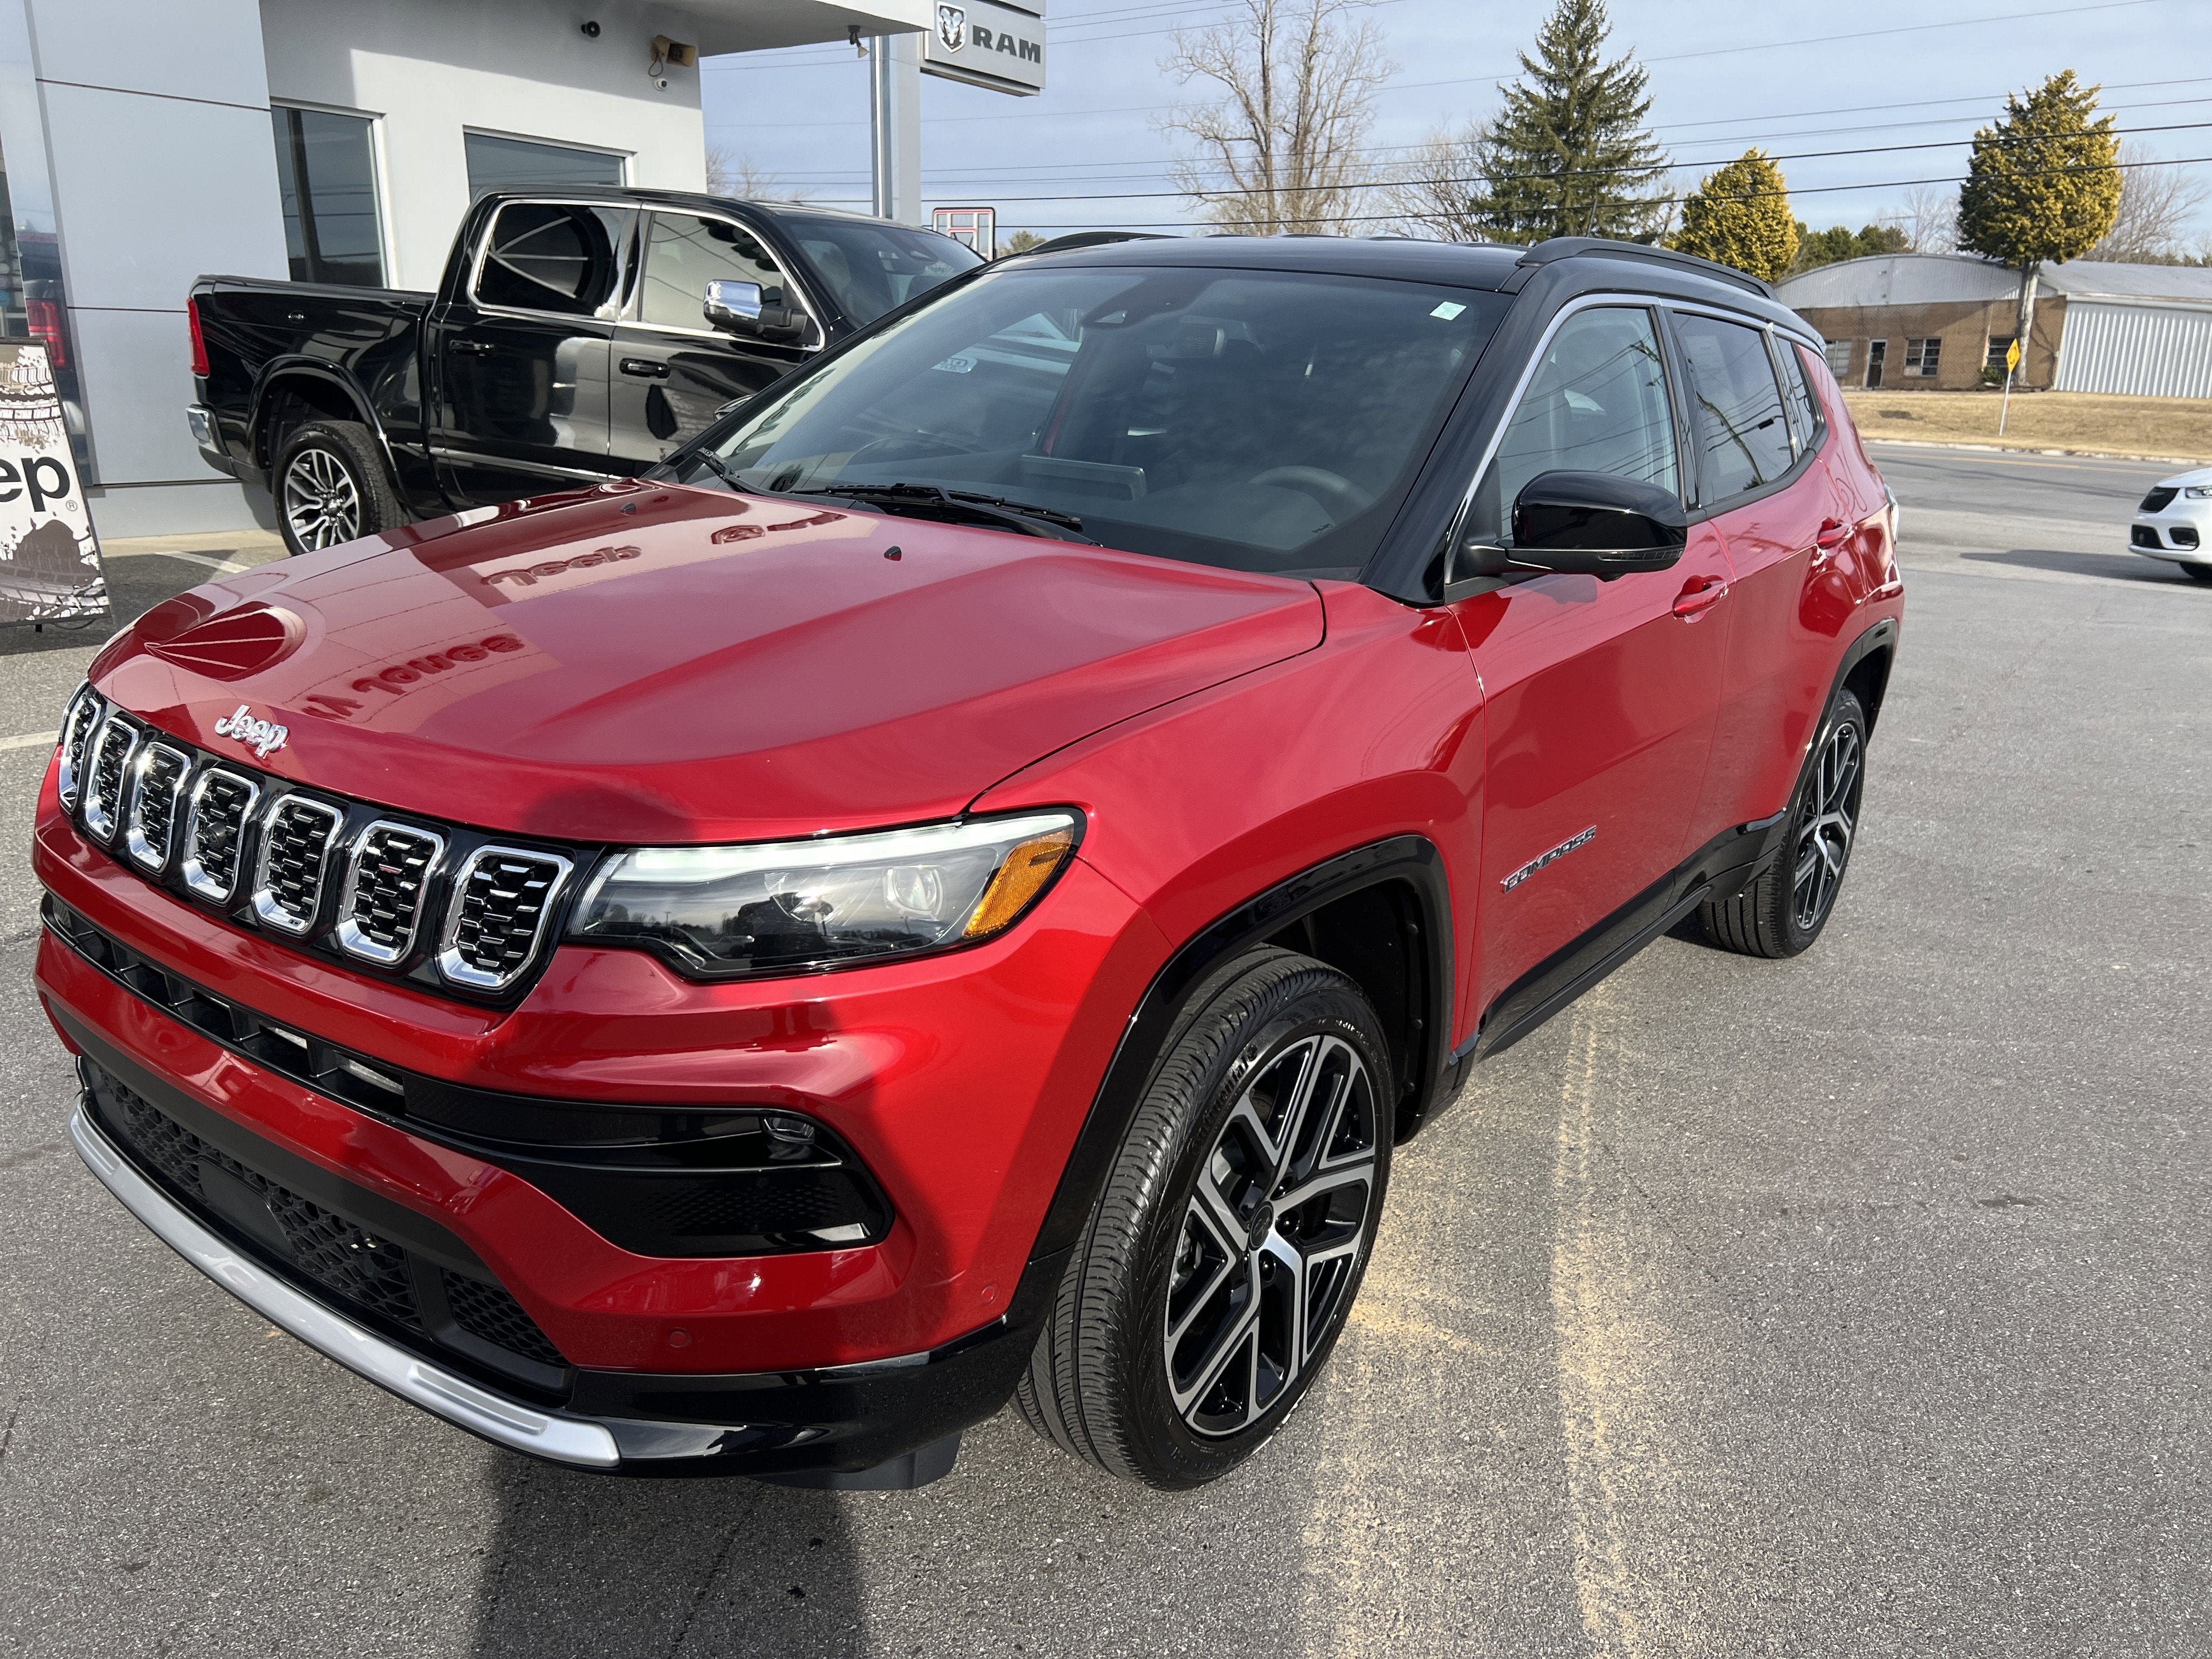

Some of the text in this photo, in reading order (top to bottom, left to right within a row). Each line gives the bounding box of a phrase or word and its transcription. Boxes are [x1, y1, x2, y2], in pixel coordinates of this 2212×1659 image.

[973, 25, 1041, 64] RAM
[215, 704, 289, 757] Jeep
[1502, 825, 1597, 893] COMPASS
